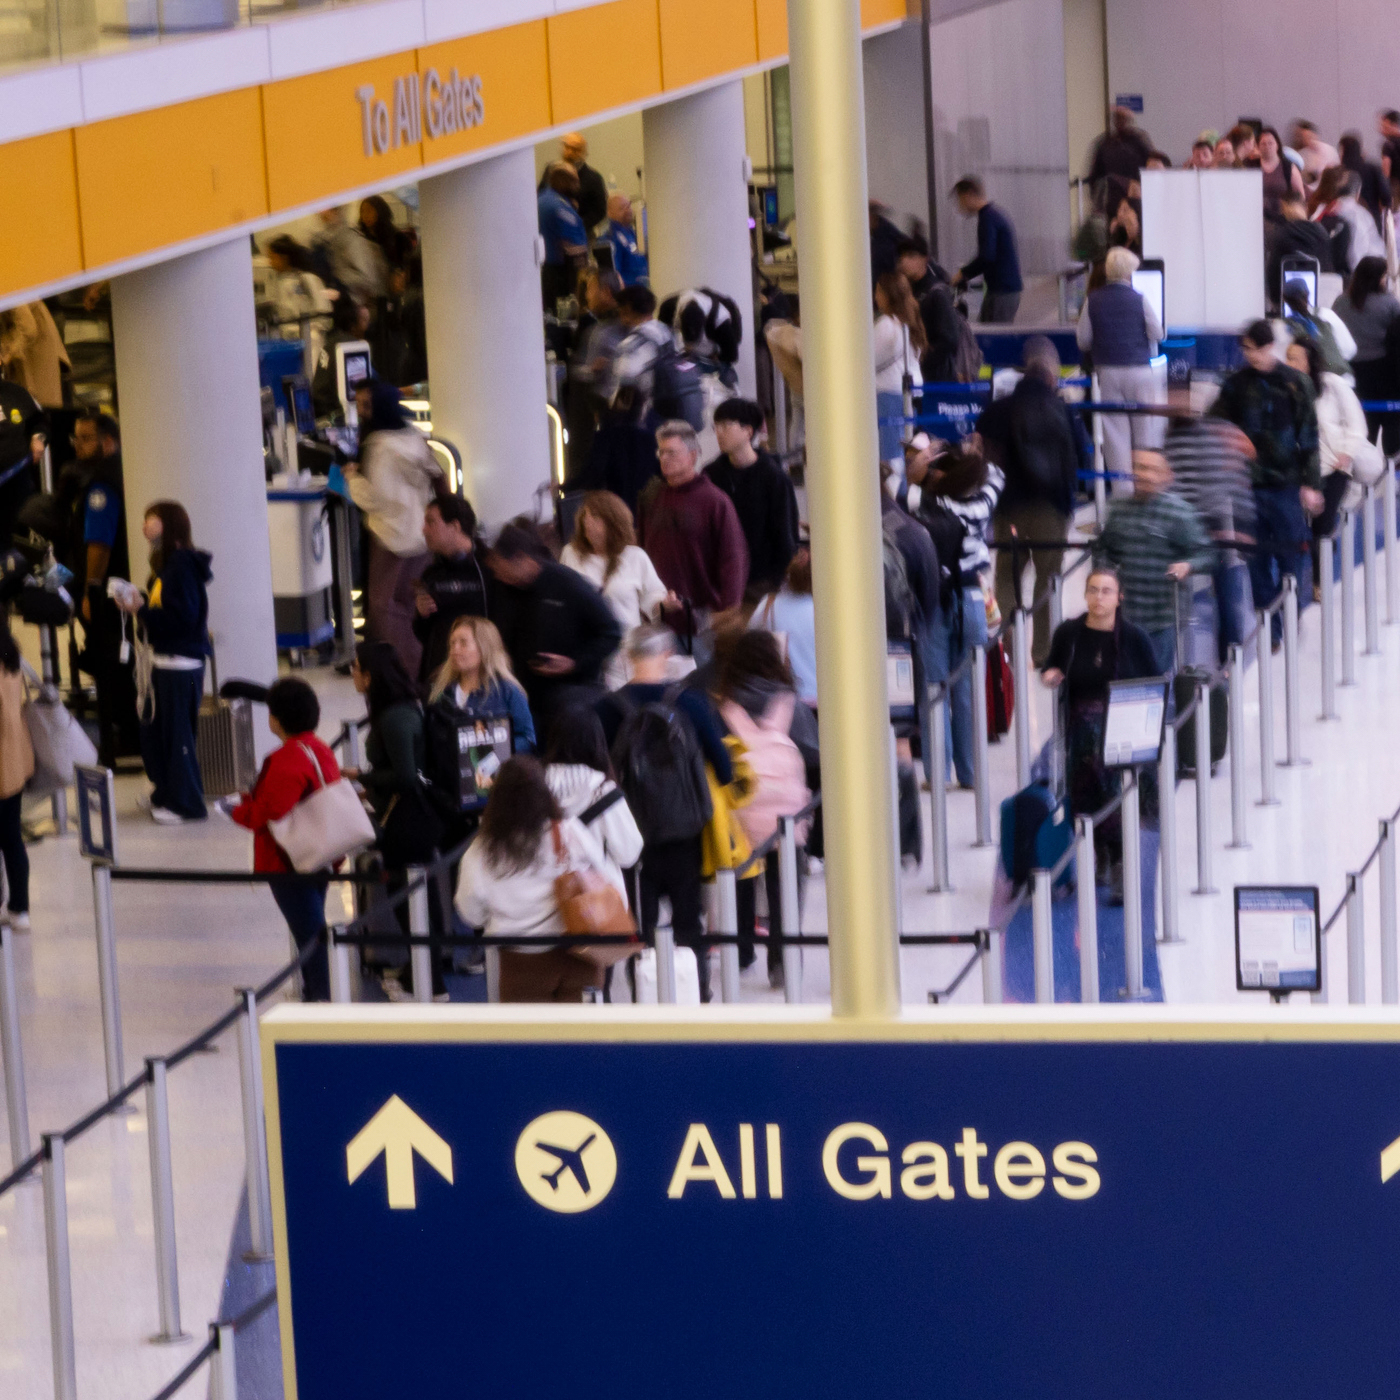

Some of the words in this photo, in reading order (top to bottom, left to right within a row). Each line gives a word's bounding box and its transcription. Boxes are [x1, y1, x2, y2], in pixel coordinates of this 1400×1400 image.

[355, 83, 390, 157] To
[392, 73, 422, 150] All
[423, 66, 484, 139] Gates
[667, 1123, 783, 1200] All
[822, 1122, 1102, 1202] Gates
